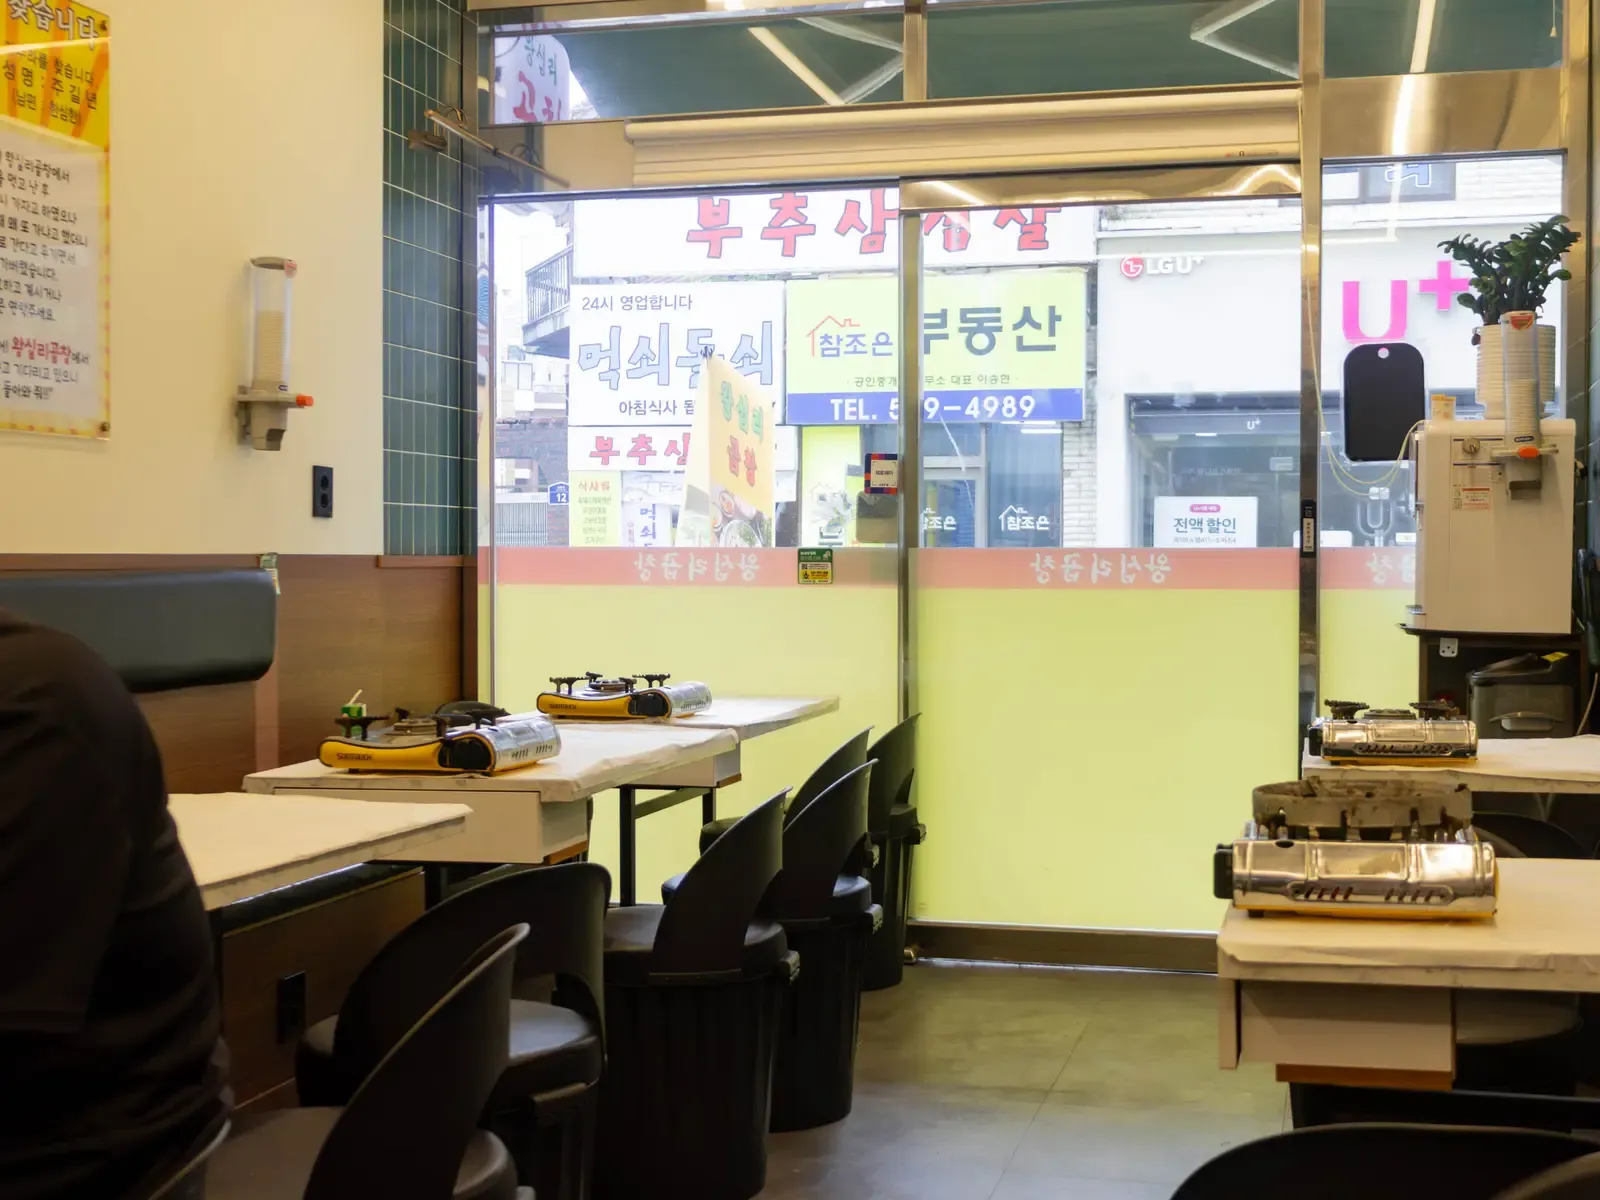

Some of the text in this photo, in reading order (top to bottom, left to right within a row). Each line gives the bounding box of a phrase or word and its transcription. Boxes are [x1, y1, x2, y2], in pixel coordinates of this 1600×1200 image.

[582, 294, 693, 311] 24시 영업합니다
[1342, 260, 1470, 344] U+
[819, 332, 894, 358] 참조은
[951, 374, 972, 386] 대표
[619, 399, 678, 416] 아침식사
[830, 395, 1036, 421] TEL. 59-4989
[556, 492, 567, 503] 12
[1173, 517, 1237, 534] 전액 할인
